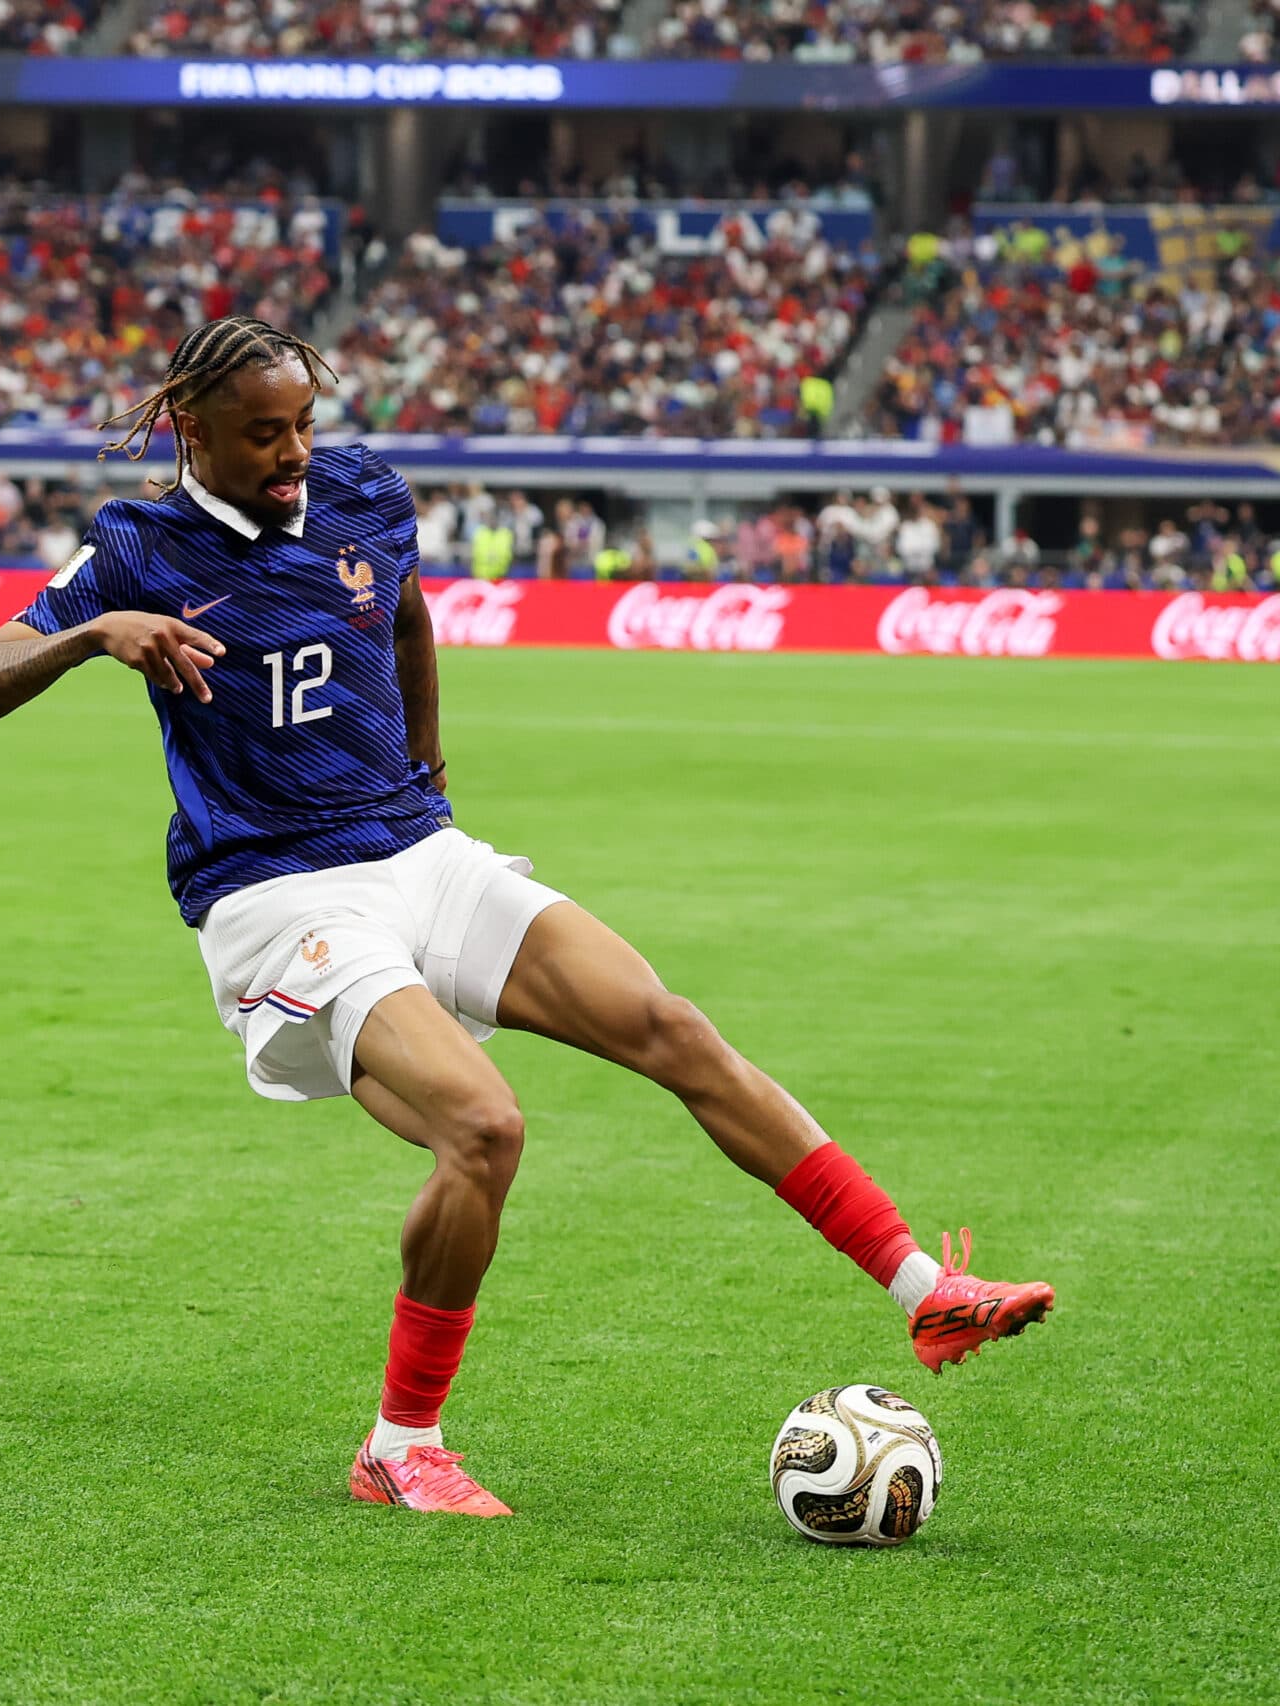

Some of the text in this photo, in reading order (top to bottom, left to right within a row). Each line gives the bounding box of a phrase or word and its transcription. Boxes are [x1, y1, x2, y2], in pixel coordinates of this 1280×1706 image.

[180, 63, 254, 99] FIFA
[255, 63, 374, 99] WORLD
[375, 64, 443, 100] CUP
[608, 581, 792, 651] Coca-Cola
[877, 586, 1065, 656] Coca-Cola
[263, 642, 333, 729] 12
[912, 1298, 1005, 1339] F50
